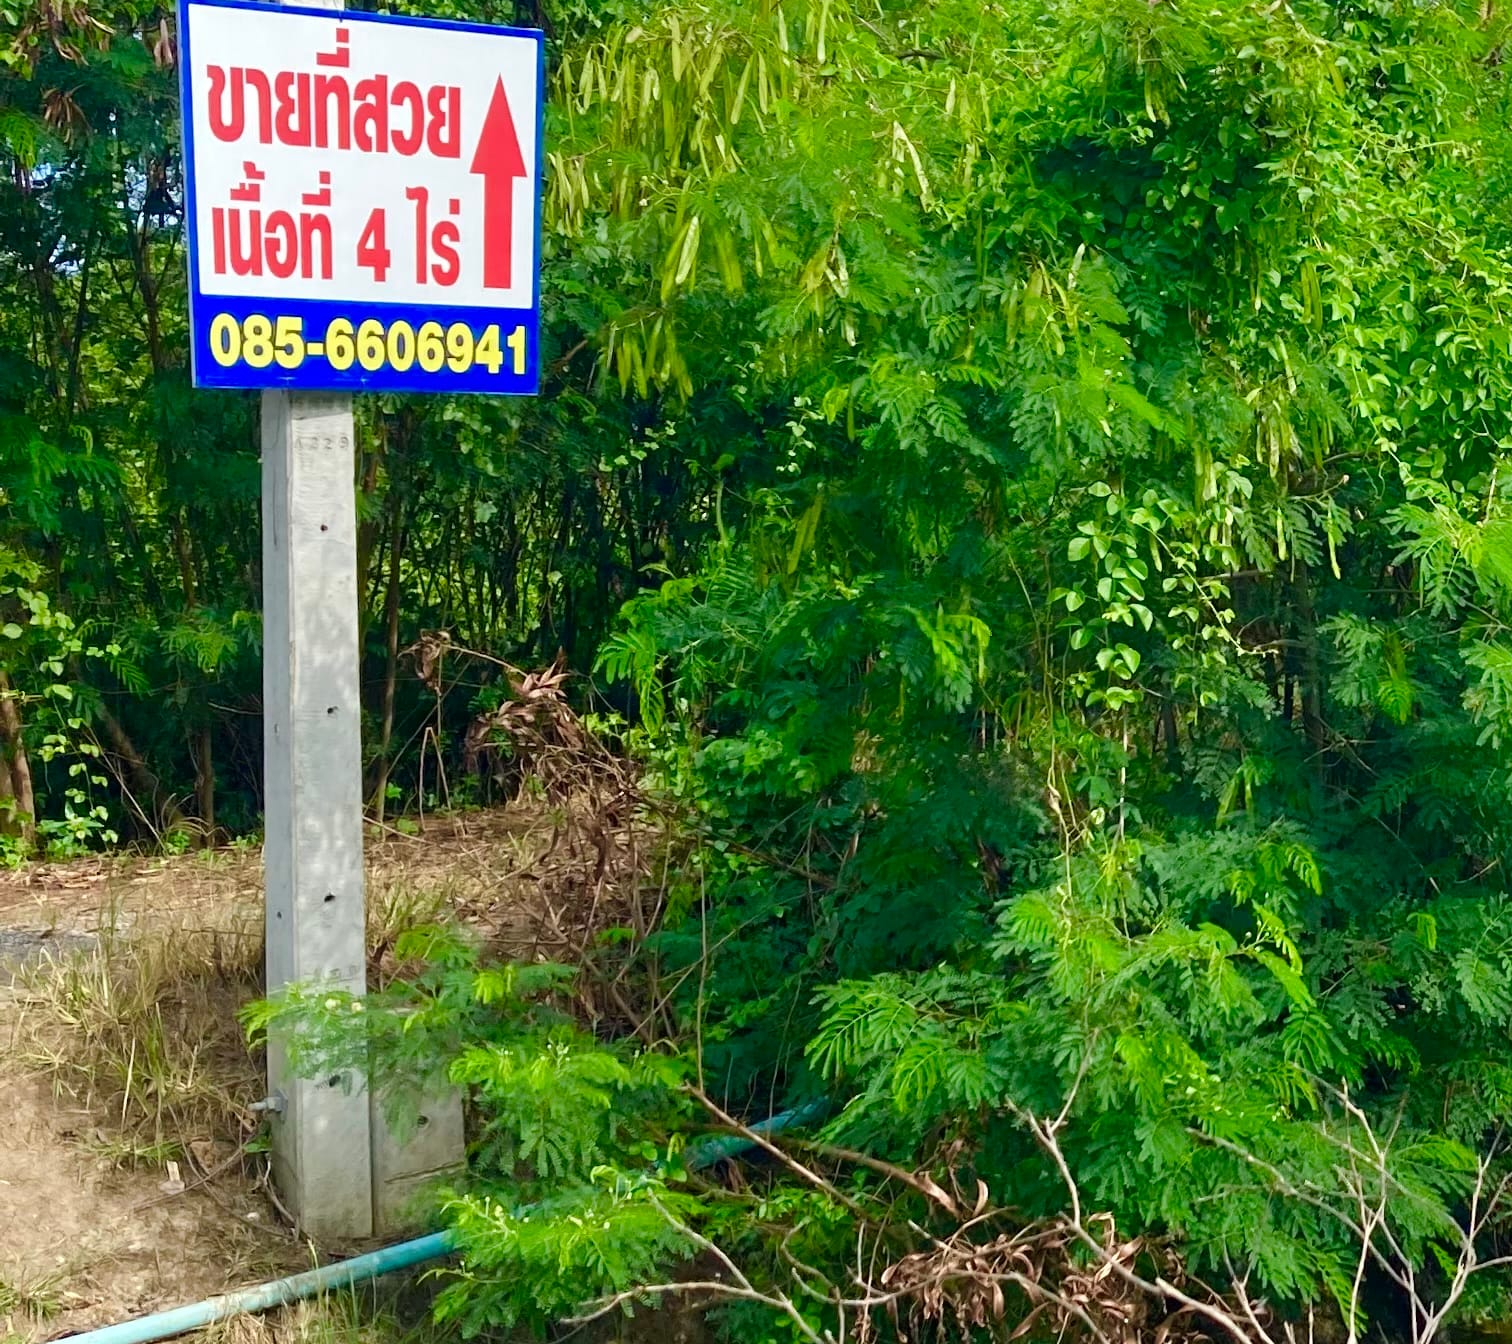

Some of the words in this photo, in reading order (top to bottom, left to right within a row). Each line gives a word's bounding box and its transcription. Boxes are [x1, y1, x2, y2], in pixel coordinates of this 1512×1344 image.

[207, 28, 461, 159] ขายที่สวย
[212, 161, 333, 281] เนื้อที่
[356, 208, 391, 283] 4
[405, 186, 461, 287] ไร่
[209, 312, 527, 376] 085-6606941
